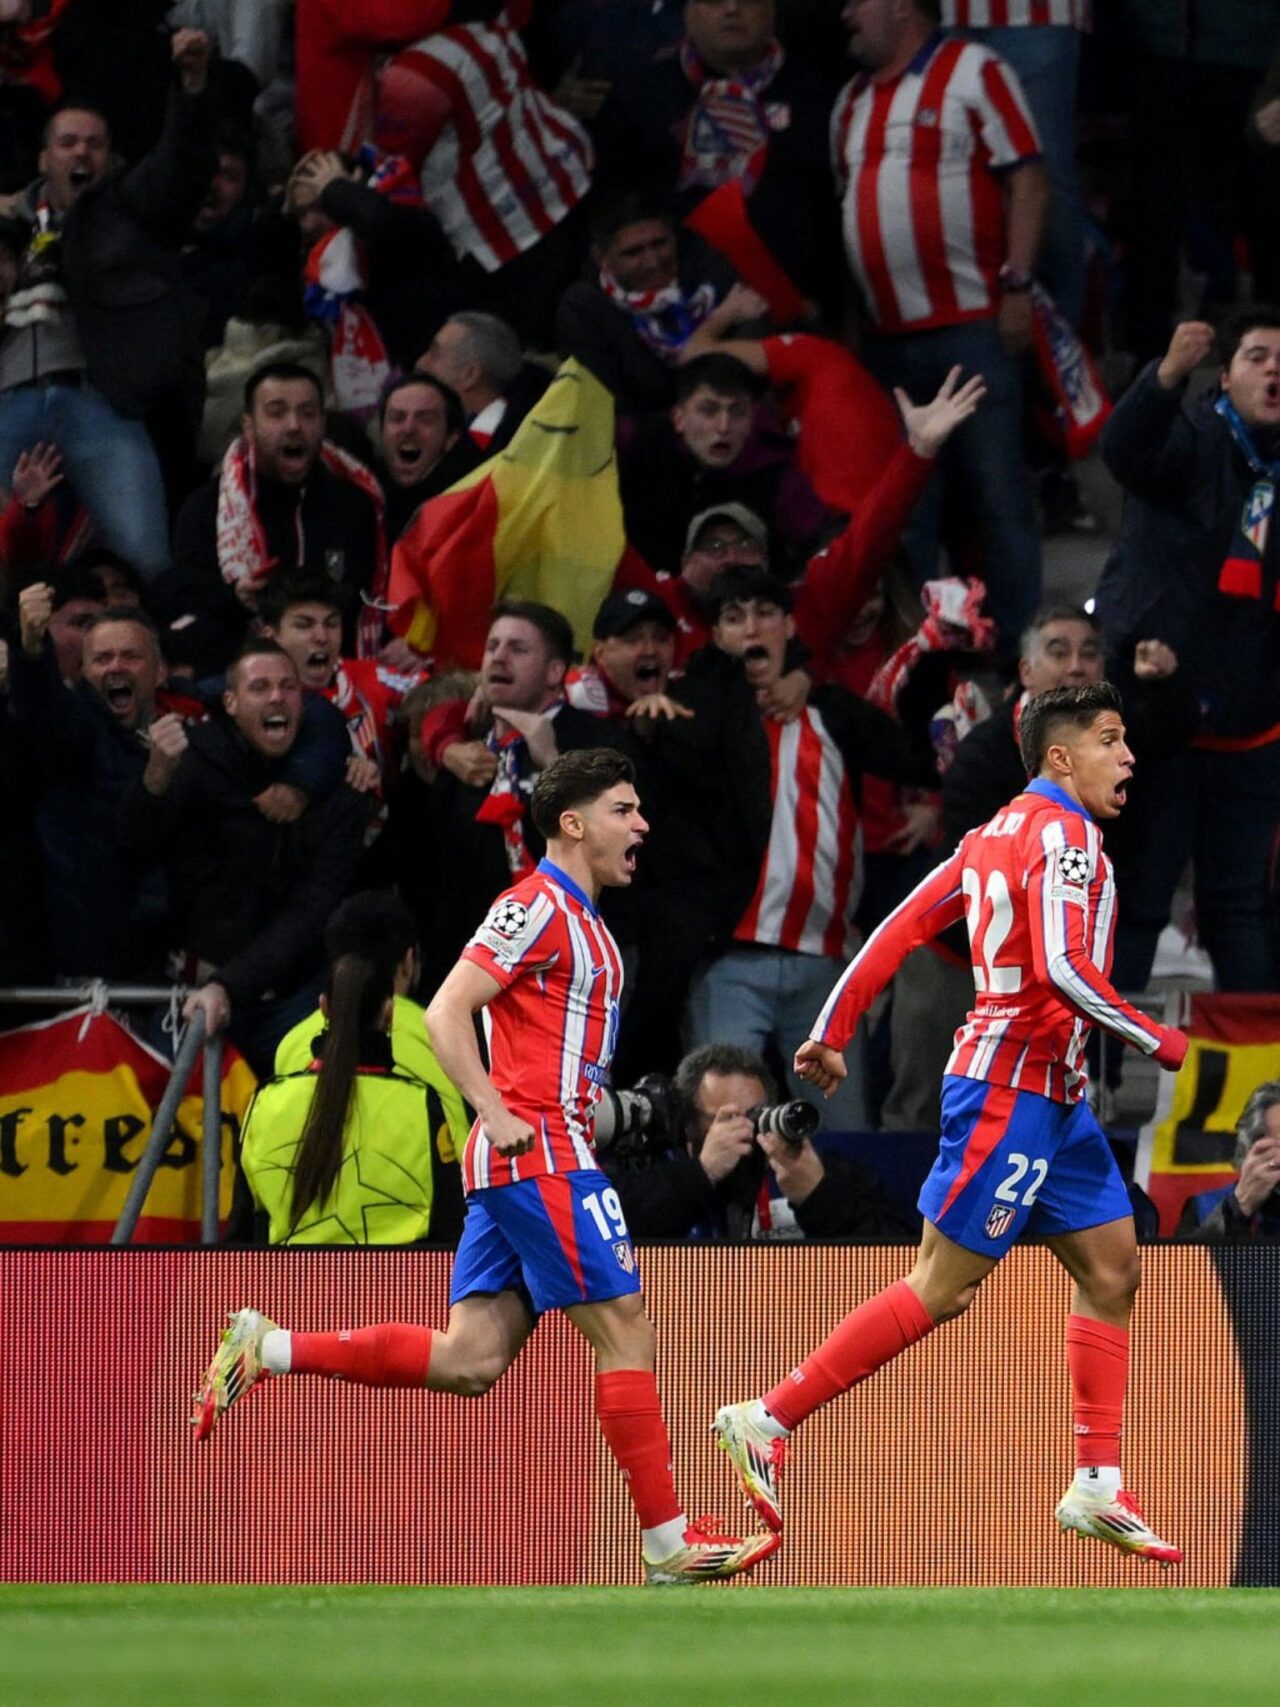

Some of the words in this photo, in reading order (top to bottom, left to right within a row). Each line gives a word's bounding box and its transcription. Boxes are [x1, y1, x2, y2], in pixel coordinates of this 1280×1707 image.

[962, 867, 1022, 993] 22
[994, 1152, 1049, 1206] 22
[582, 1187, 627, 1242] 19
